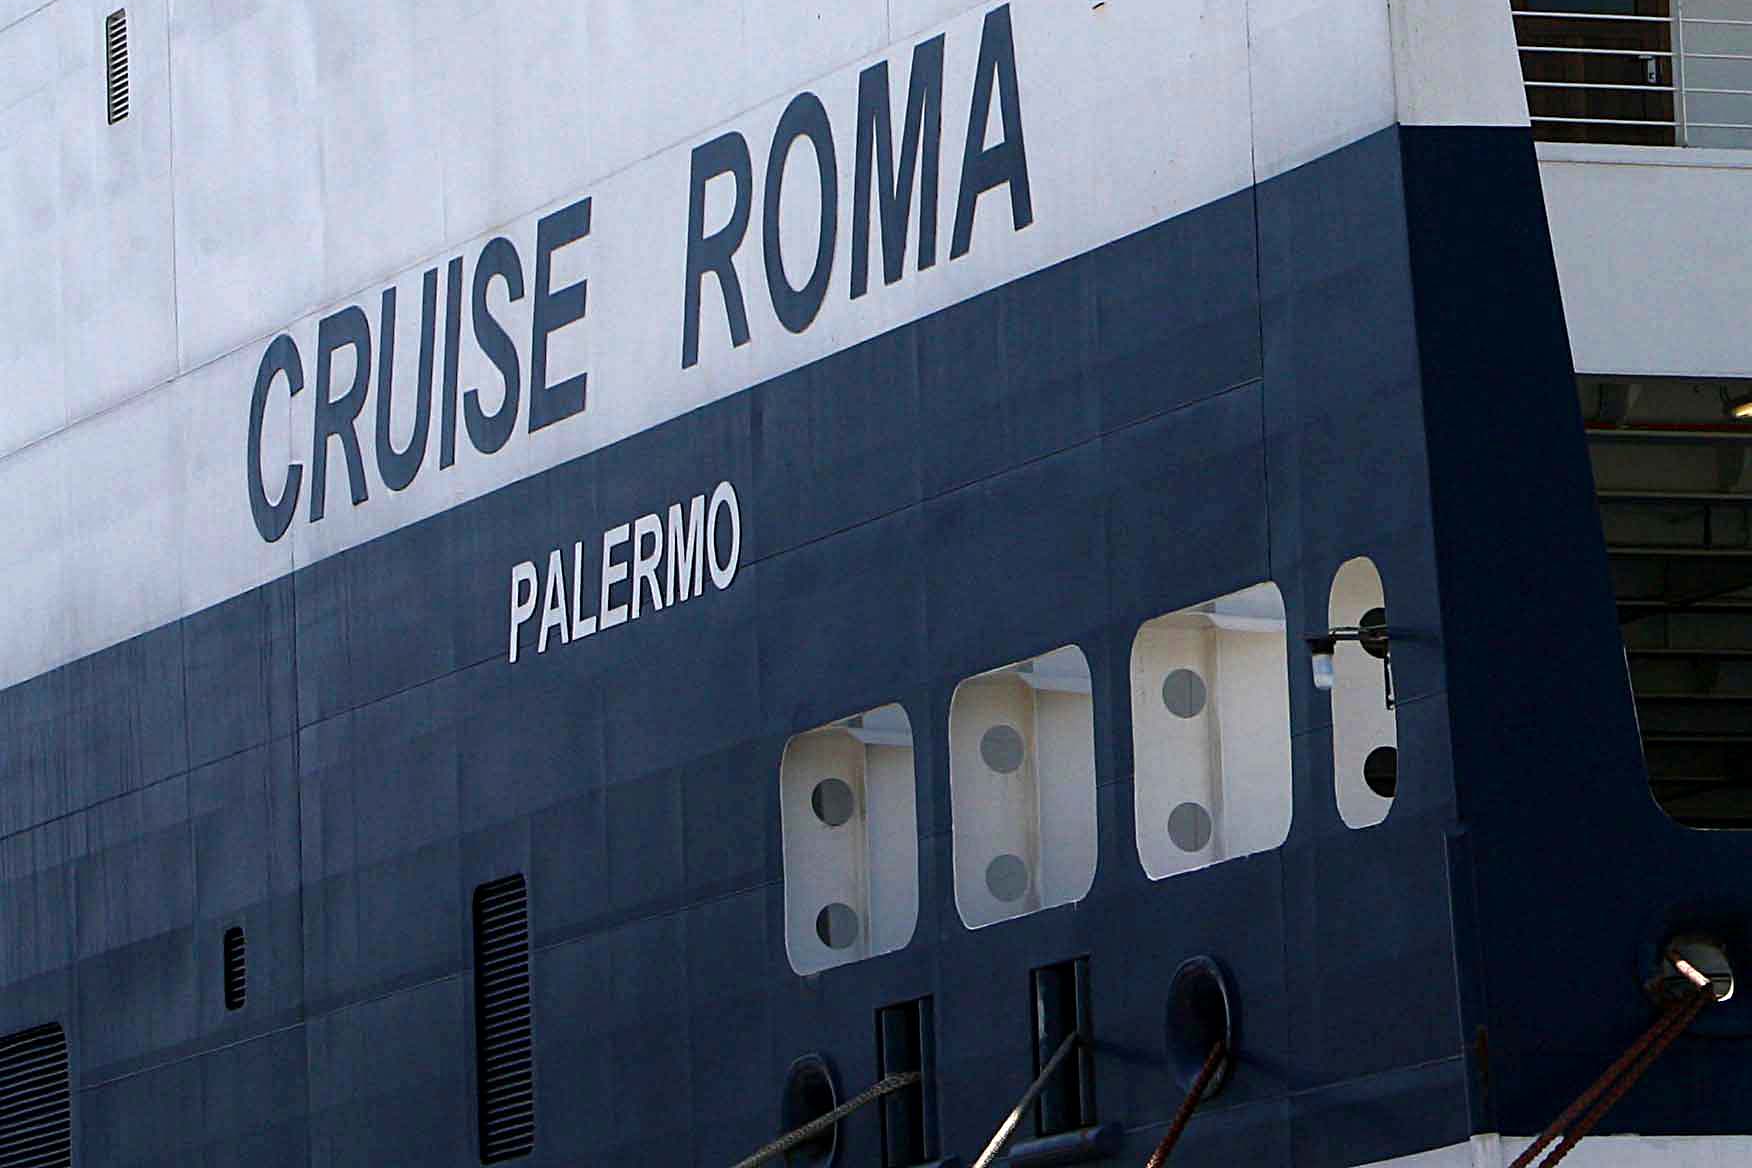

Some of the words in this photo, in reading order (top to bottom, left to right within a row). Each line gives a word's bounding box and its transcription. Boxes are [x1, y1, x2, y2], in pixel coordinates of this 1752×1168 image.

[247, 196, 592, 544] CRUISE
[681, 2, 1034, 370] ROMA
[508, 481, 741, 664] PALERMO
